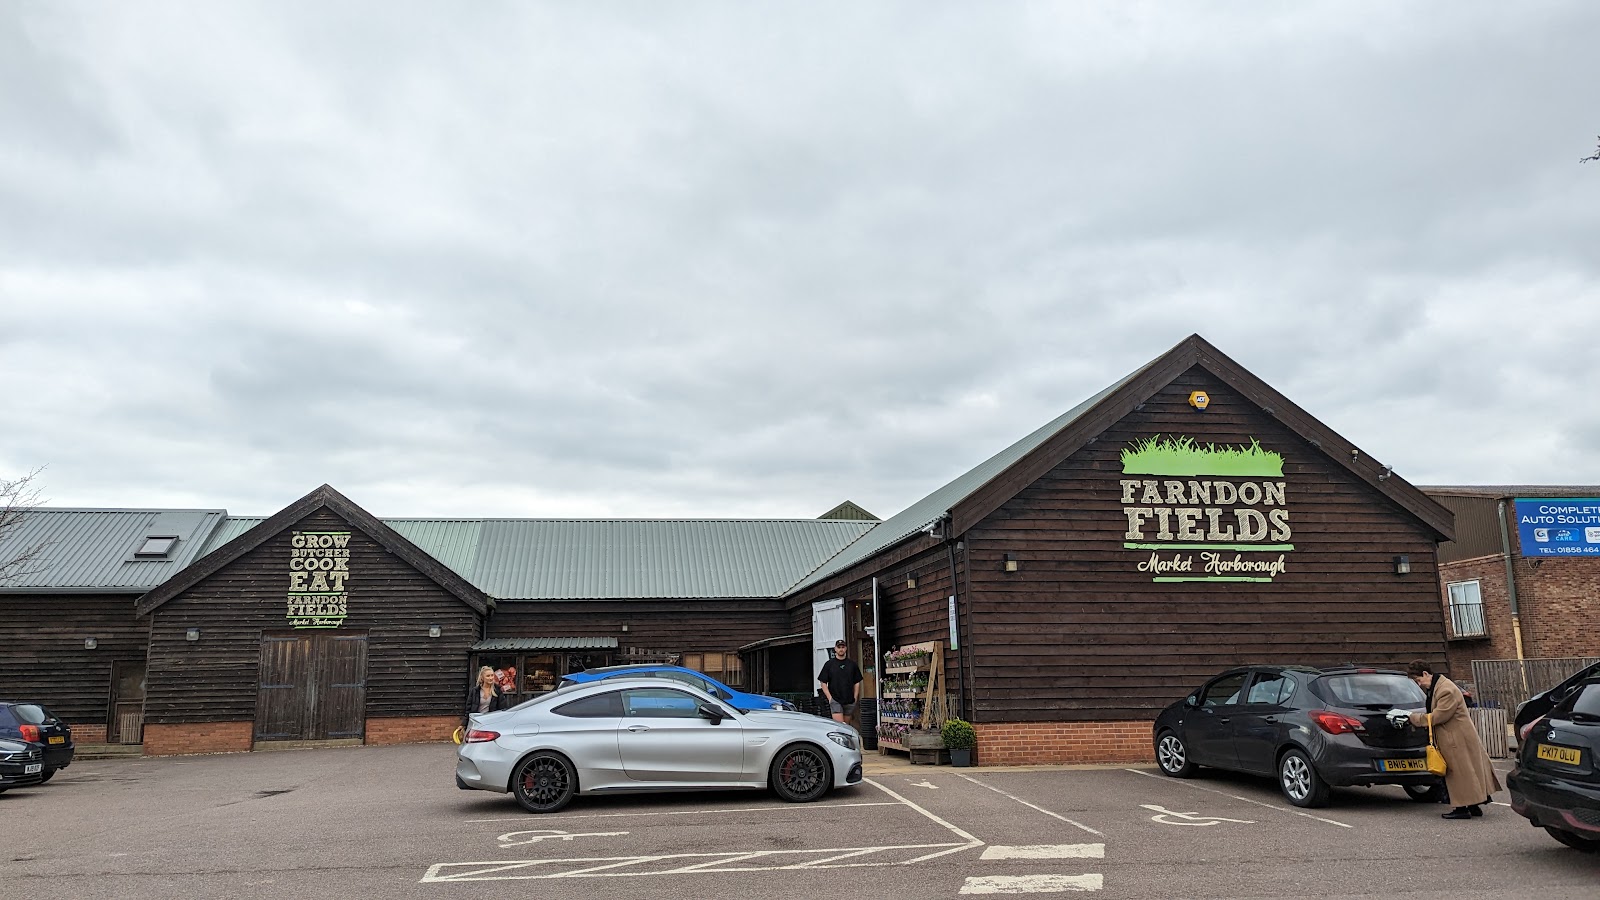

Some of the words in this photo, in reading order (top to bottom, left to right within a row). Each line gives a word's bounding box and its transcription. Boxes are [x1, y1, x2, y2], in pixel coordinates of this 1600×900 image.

[1120, 480, 1286, 505] FARNDON
[1539, 505, 1600, 514] COMPLET
[1124, 507, 1292, 541] FIELDS
[1521, 515, 1555, 524] AUTO
[291, 535, 351, 548] GROW
[291, 549, 350, 557] BUTCHER
[290, 558, 350, 570] COOK
[1137, 552, 1192, 574] Market
[1200, 552, 1286, 577] Harborough
[289, 572, 349, 591] EAT
[287, 596, 347, 604] FARNDON
[287, 604, 347, 615] FIELDS
[1541, 746, 1558, 759] PK17
[1387, 760, 1407, 769] BN16
